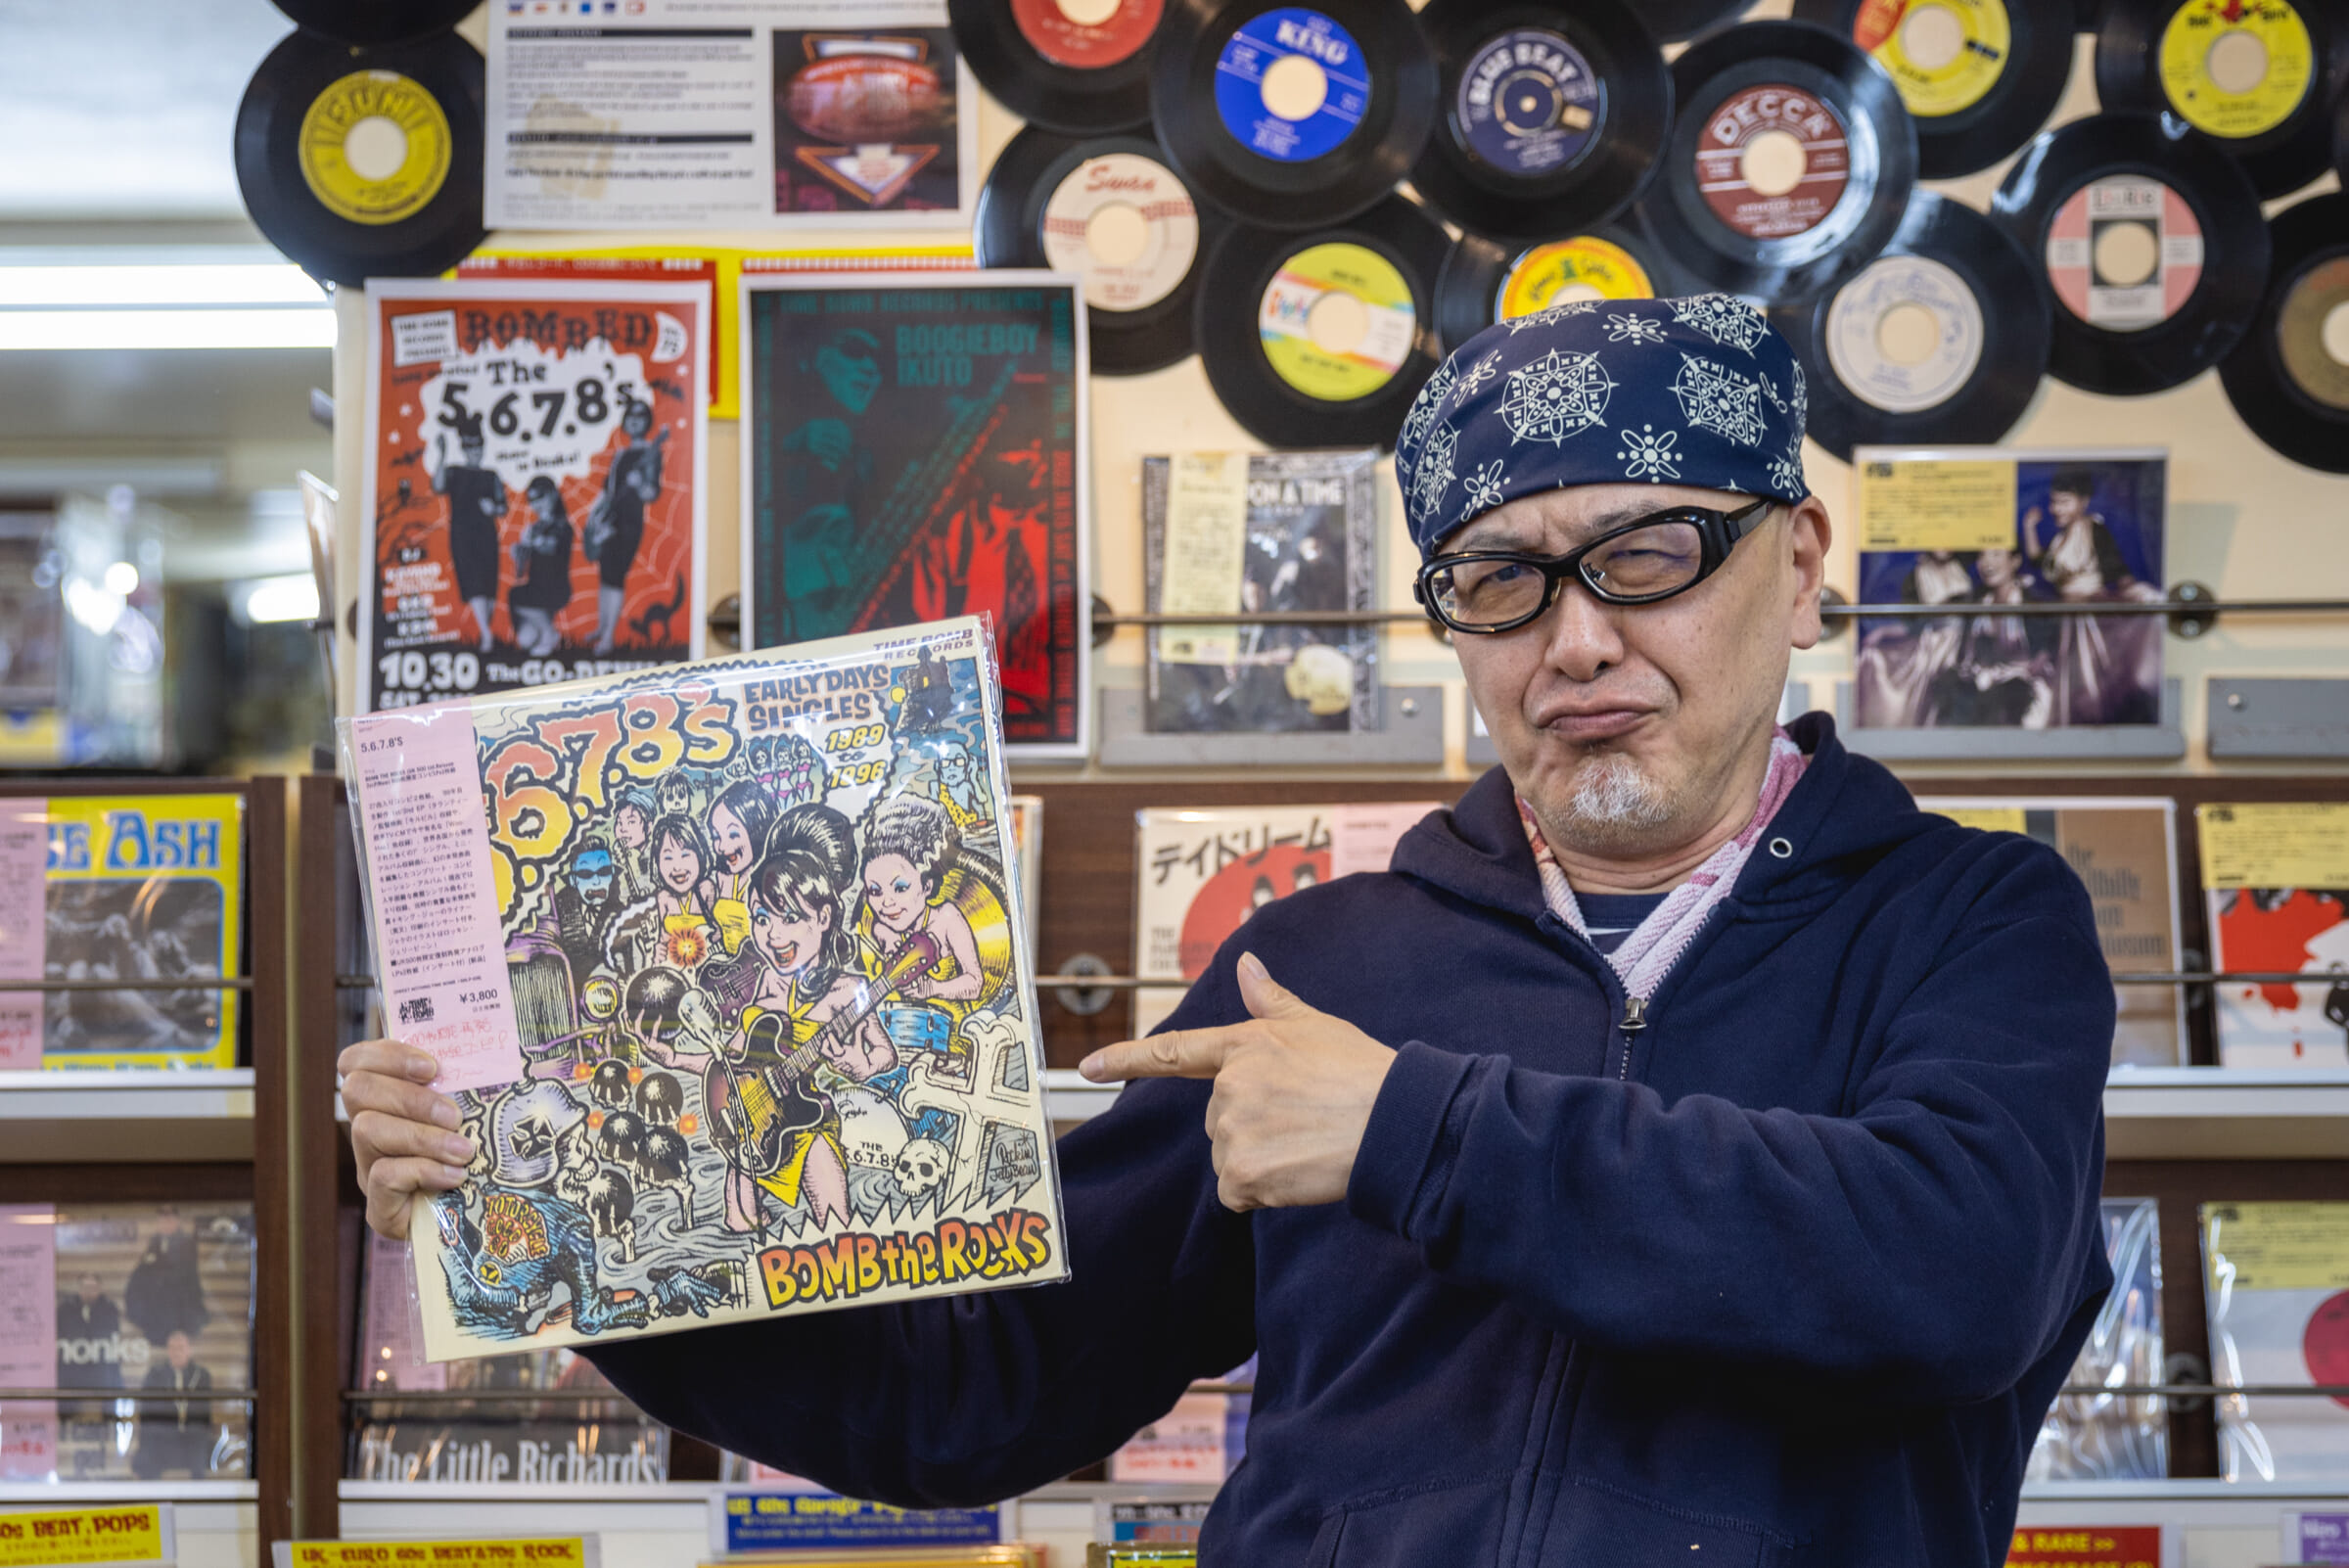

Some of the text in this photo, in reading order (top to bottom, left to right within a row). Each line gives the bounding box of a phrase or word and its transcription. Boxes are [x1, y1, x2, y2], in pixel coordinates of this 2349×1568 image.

[1276, 18, 1349, 66] KING
[1468, 42, 1579, 106] BLUE BEAT
[1713, 94, 1830, 147] DECCA
[464, 308, 653, 351] BOMBED
[895, 322, 1040, 356] BOOGIEBOY
[487, 359, 546, 386] The
[896, 355, 974, 388] IKUTO
[437, 362, 636, 442] 56.7.8's
[874, 636, 917, 652] TIME
[379, 650, 480, 691] 10.30
[486, 659, 675, 685] The GO-DE
[742, 662, 892, 706] EARLY DAYS
[747, 690, 873, 734] SINGLES
[360, 736, 404, 754] 5.6.7.8'S
[826, 723, 885, 754] 1989
[830, 761, 887, 789] 1996
[104, 807, 223, 871] ASH
[459, 989, 498, 1003] ¥3,800
[860, 1140, 883, 1153] THE
[756, 1231, 881, 1311] BOMB
[933, 1208, 1052, 1283] ROCKS
[362, 1439, 659, 1485] The Little Richards
[523, 1543, 576, 1561] ROCK
[2033, 1532, 2092, 1553] RARE
